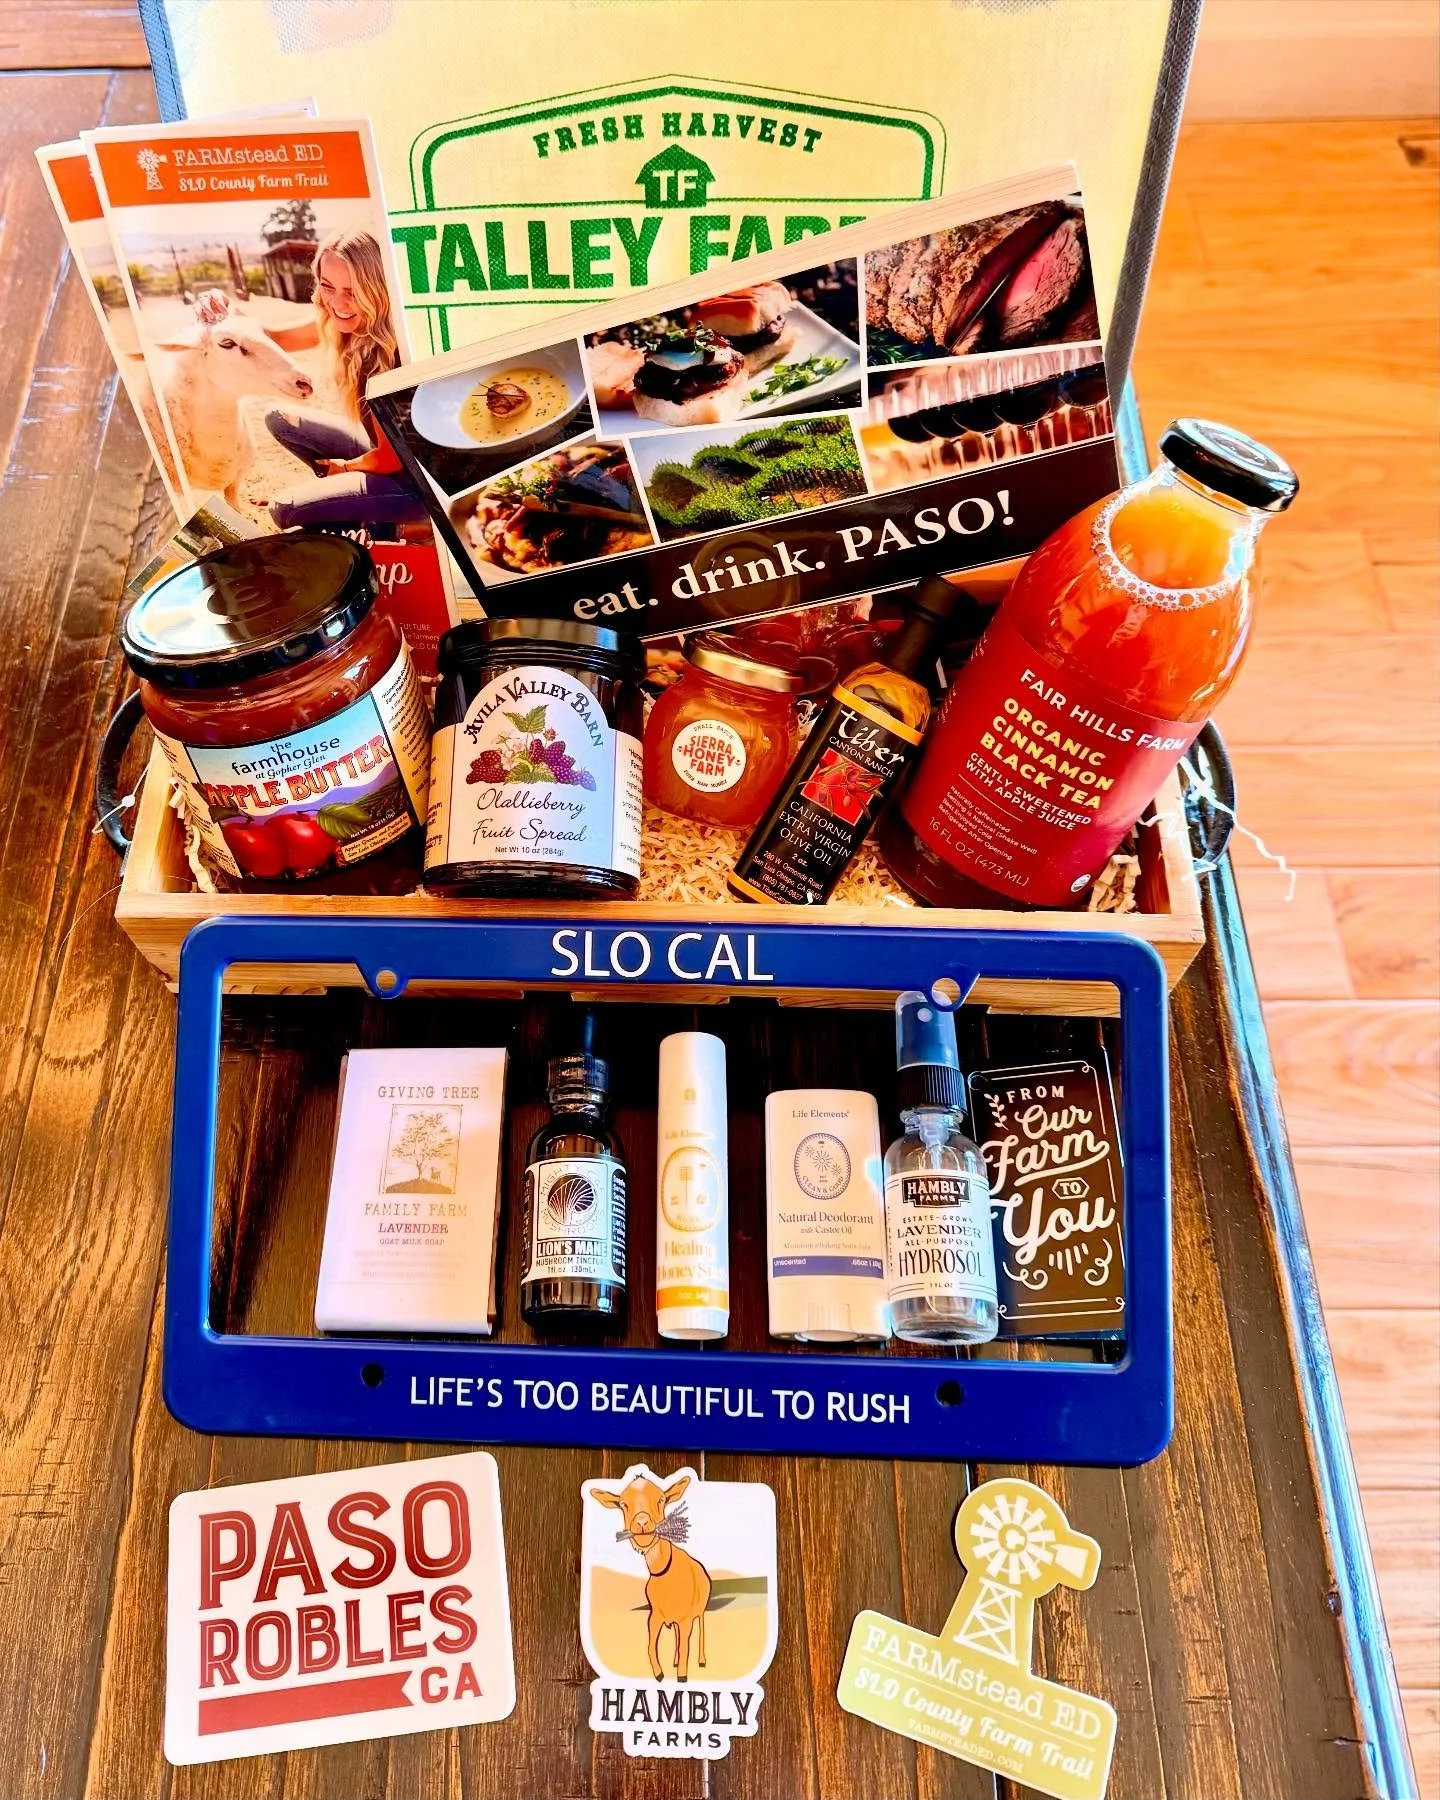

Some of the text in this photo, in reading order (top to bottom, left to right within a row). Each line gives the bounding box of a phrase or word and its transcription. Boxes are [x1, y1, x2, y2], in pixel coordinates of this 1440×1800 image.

[532, 110, 824, 158] FRESH HARVEST
[172, 143, 324, 167] FARMstead ED
[179, 172, 329, 193] SLO County Farm Trail
[652, 169, 699, 202] TF
[392, 216, 664, 295] TALLEY
[572, 489, 1017, 622] eat. drink. PASO!
[463, 693, 507, 745] AVILA
[502, 676, 572, 703] VALLEY
[570, 691, 604, 748] BARN
[1020, 668, 1068, 711] FAIR
[1069, 703, 1135, 743] HILLS
[270, 740, 293, 753] the
[688, 735, 733, 756] SIERRA
[1003, 697, 1107, 767] ORGANIC
[231, 736, 341, 776] farmhouse
[255, 754, 327, 780] at Gopher Glen
[682, 744, 736, 768] HONEY
[689, 758, 726, 777] FARM
[829, 736, 895, 779] CANYON RANCH
[992, 715, 1114, 792] CINNAMON
[197, 780, 289, 810] APPLE
[285, 734, 392, 802] BUTTER
[979, 731, 1101, 810] BLACK TEA
[476, 788, 586, 820] Olallieberry
[965, 759, 1077, 831] WITH APPLE JUICE
[969, 752, 1092, 826] GENTLY SWEETENED
[789, 800, 853, 845] CALIFORNIA
[942, 797, 993, 840] Best Enjoyed Cold
[950, 786, 1011, 833] Naturally Caffeinated
[972, 814, 996, 834] Natural
[350, 831, 361, 839] Net
[472, 817, 590, 847] Fruit Spread
[778, 810, 852, 859] EXTRA VIRGIN
[780, 827, 833, 867] OLIVE OIL
[938, 803, 1013, 861] Refrigerate After Opening
[494, 846, 507, 854] Net
[508, 846, 519, 855] Wt
[521, 846, 531, 855] 10
[791, 853, 799, 861] 2
[928, 816, 1030, 887] 16 FL OZ (473 ML)
[752, 855, 765, 867] San
[763, 862, 777, 874] Luis
[796, 882, 807, 892] CA
[762, 873, 778, 888] (805)
[807, 877, 824, 890] Road
[550, 929, 774, 981] SLO CAL
[377, 1085, 480, 1099] GIVING TREE
[1006, 1085, 1065, 1104] FROM
[792, 1109, 808, 1119] Life
[1013, 1104, 1093, 1140] Our
[980, 1128, 1111, 1195] Farm
[802, 1175, 822, 1194] CLEAN
[828, 1176, 845, 1192] GOOD
[907, 1179, 966, 1196] HAMBLY
[919, 1194, 956, 1203] FARMS
[1059, 1181, 1082, 1196] TO
[363, 1202, 468, 1217] FAMILY FARM
[778, 1211, 874, 1225] Natural Deodorant
[377, 1222, 450, 1235] LAVENDER
[815, 1225, 840, 1235] Castor
[841, 1226, 853, 1235] Oil
[896, 1224, 982, 1239] LAVENDER
[989, 1187, 1116, 1265] You
[537, 1240, 607, 1257] LION'S MANE
[664, 1240, 713, 1257] Healing
[904, 1238, 975, 1248] ALL-PURPOSE
[535, 1256, 573, 1267] MUSHROOM
[656, 1265, 696, 1282] Honey
[898, 1248, 986, 1279] HYDROSOL
[410, 1376, 911, 1424] LIFE'S TOO BEAUTIFUL TO RUSH
[197, 1480, 473, 1611] PASO
[197, 1584, 479, 1690] ROBLES
[419, 1662, 484, 1705] CA
[862, 1624, 1102, 1741] FARMstead ED
[599, 1688, 755, 1726] HAMBLY
[853, 1666, 1096, 1781] SLO County Farm Trail
[633, 1730, 722, 1750] FARMS
[908, 1718, 1024, 1775] FARMSTEADED.COM
